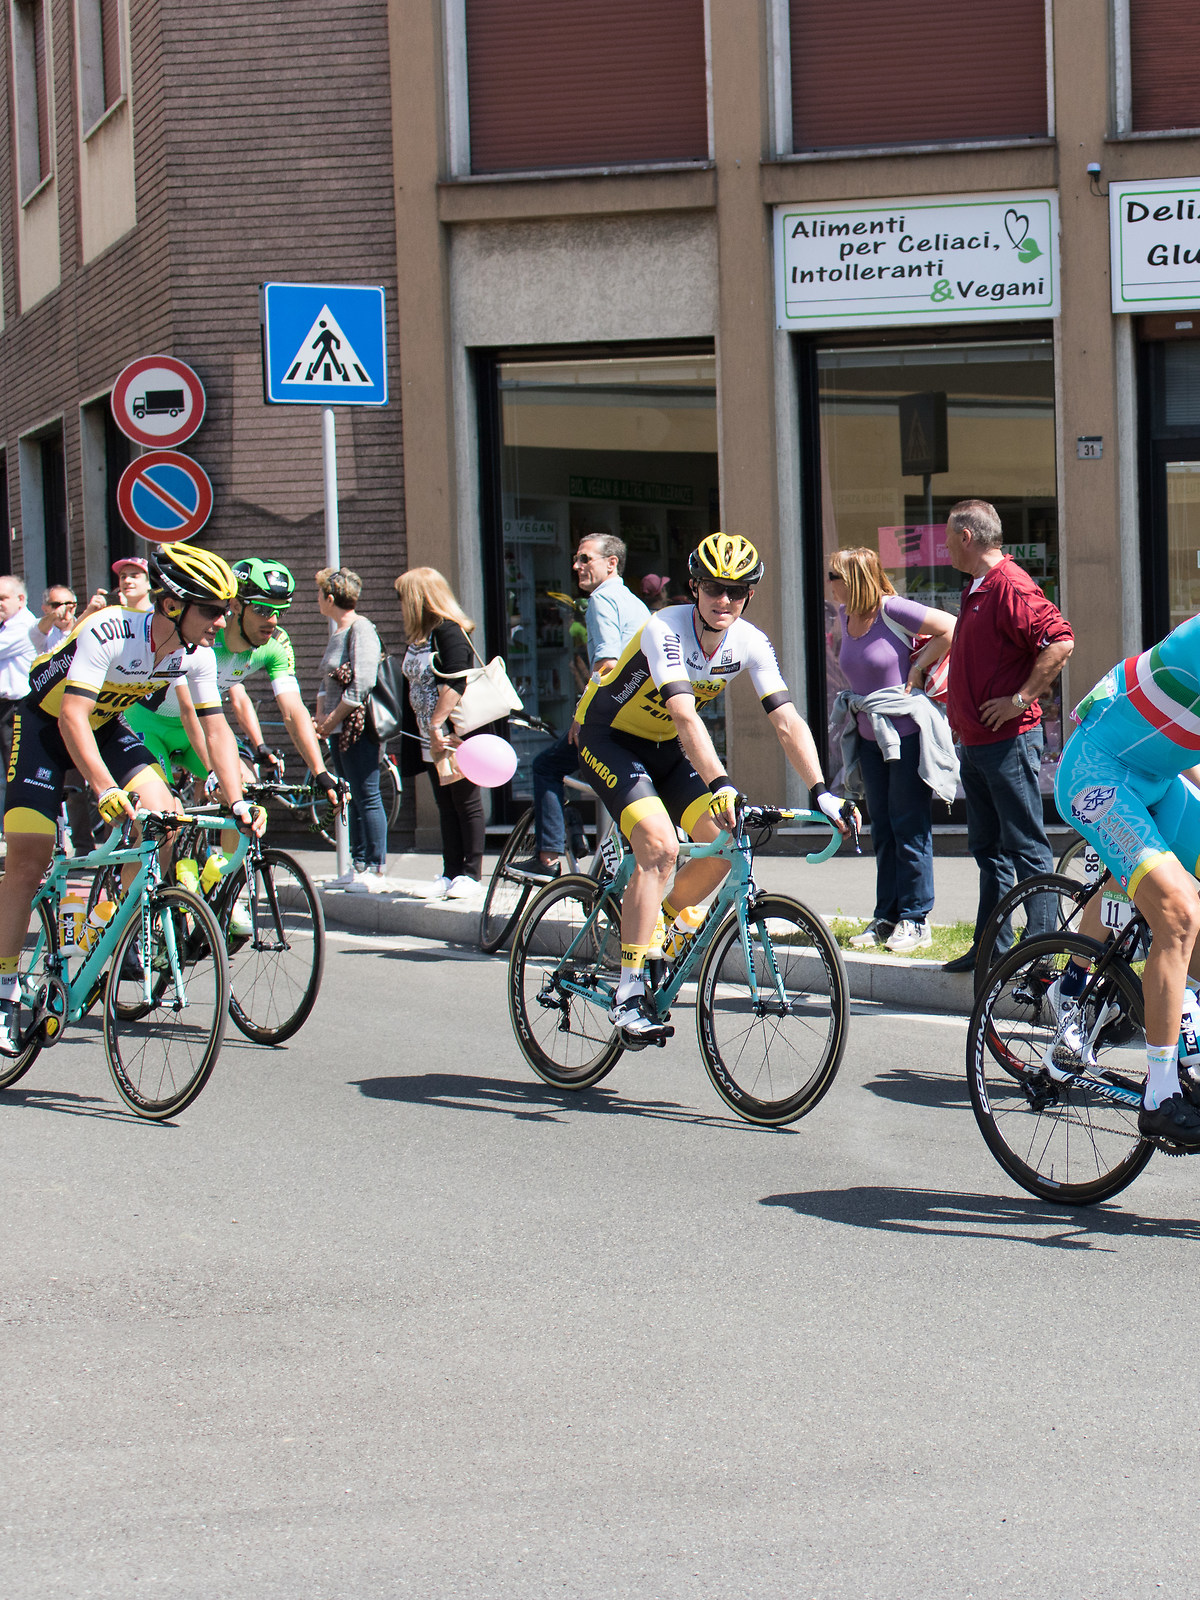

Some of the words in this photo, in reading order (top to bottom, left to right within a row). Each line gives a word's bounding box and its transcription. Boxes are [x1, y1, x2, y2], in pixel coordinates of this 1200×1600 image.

[791, 215, 906, 239] Alimenti
[839, 240, 887, 261] per
[898, 231, 1001, 253] Celiaci,
[791, 259, 944, 284] Intolleranti
[1084, 444, 1096, 457] 31
[115, 664, 149, 677] Bianchi
[611, 667, 650, 705] brandloyalty
[706, 683, 720, 692] 45
[6, 712, 22, 783] JUMBO
[580, 745, 619, 790] JUMBO
[23, 777, 56, 791] Bianchi
[1096, 826, 1135, 872] KAZYNA
[1084, 853, 1100, 873] 98
[566, 983, 593, 999] Bianchi
[1073, 1075, 1142, 1107] SPECIALIZED
